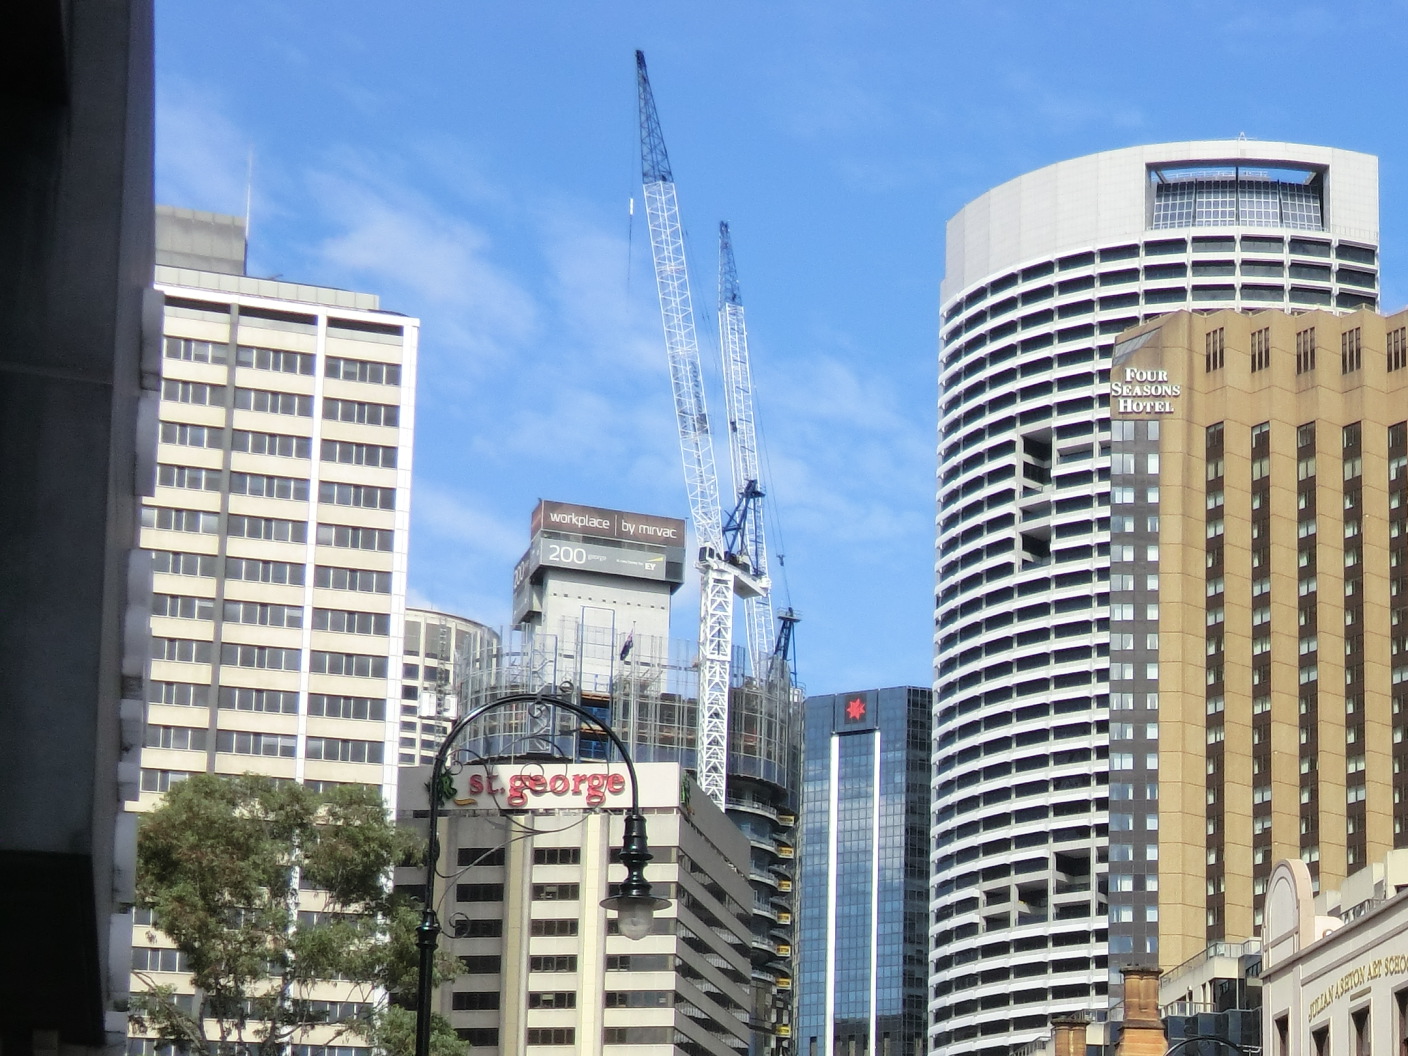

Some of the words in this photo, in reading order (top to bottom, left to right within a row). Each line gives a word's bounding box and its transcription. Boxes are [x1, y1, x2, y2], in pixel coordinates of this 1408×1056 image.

[1125, 367, 1168, 382] FOUR
[1111, 382, 1181, 397] SEASONS
[1119, 398, 1174, 413] HOTEL
[549, 511, 610, 530] workplace
[621, 519, 635, 535] by
[638, 523, 677, 539] mirvac
[549, 544, 587, 564] 200
[1308, 984, 1334, 1022] JULIAN
[1335, 965, 1365, 999] ASHTON
[1367, 959, 1382, 982] ART
